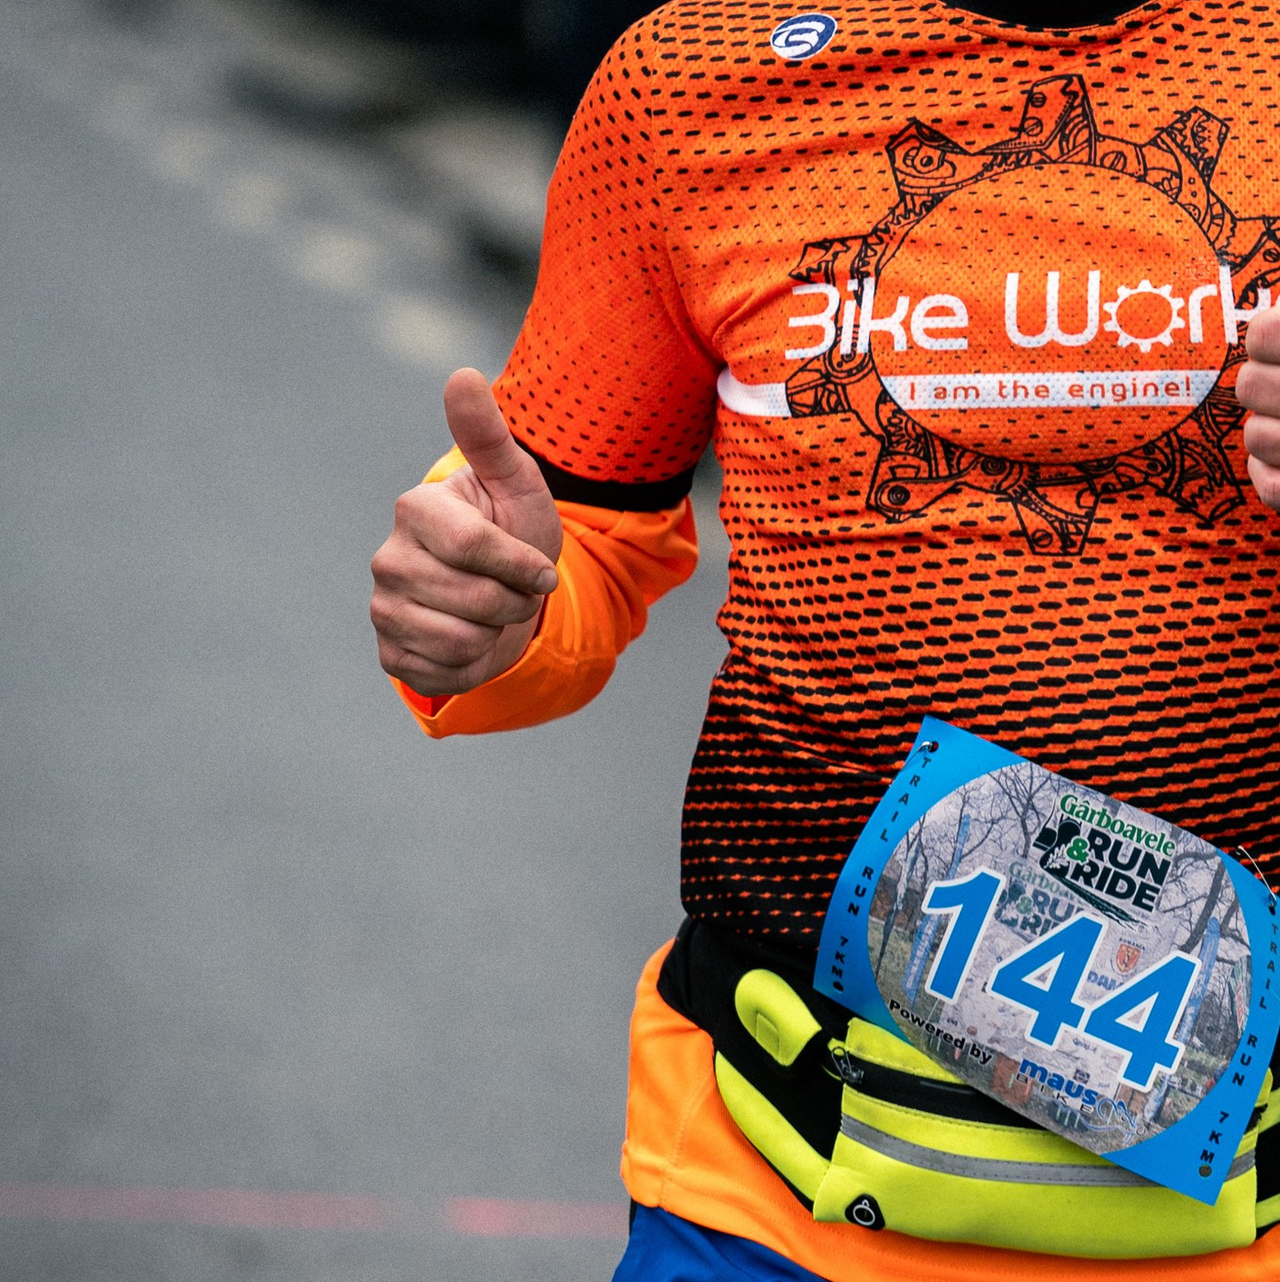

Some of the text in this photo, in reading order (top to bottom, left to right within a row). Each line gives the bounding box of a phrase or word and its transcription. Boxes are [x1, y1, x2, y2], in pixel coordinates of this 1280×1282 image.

[908, 376, 1192, 402] I am the engine!
[880, 756, 932, 842] TRAIL
[1059, 794, 1176, 858] Gârboavele
[1066, 837, 1089, 863] &
[1087, 827, 1172, 887] RUN
[847, 864, 874, 916] RUN
[1070, 859, 1161, 913] RIDE
[925, 868, 1199, 1090] 144
[1258, 923, 1278, 1010] TRAIL
[889, 999, 993, 1065] Powered by
[1019, 1058, 1099, 1106] maus
[1232, 1034, 1258, 1086] RUN
[1016, 1072, 1095, 1115] BIKE
